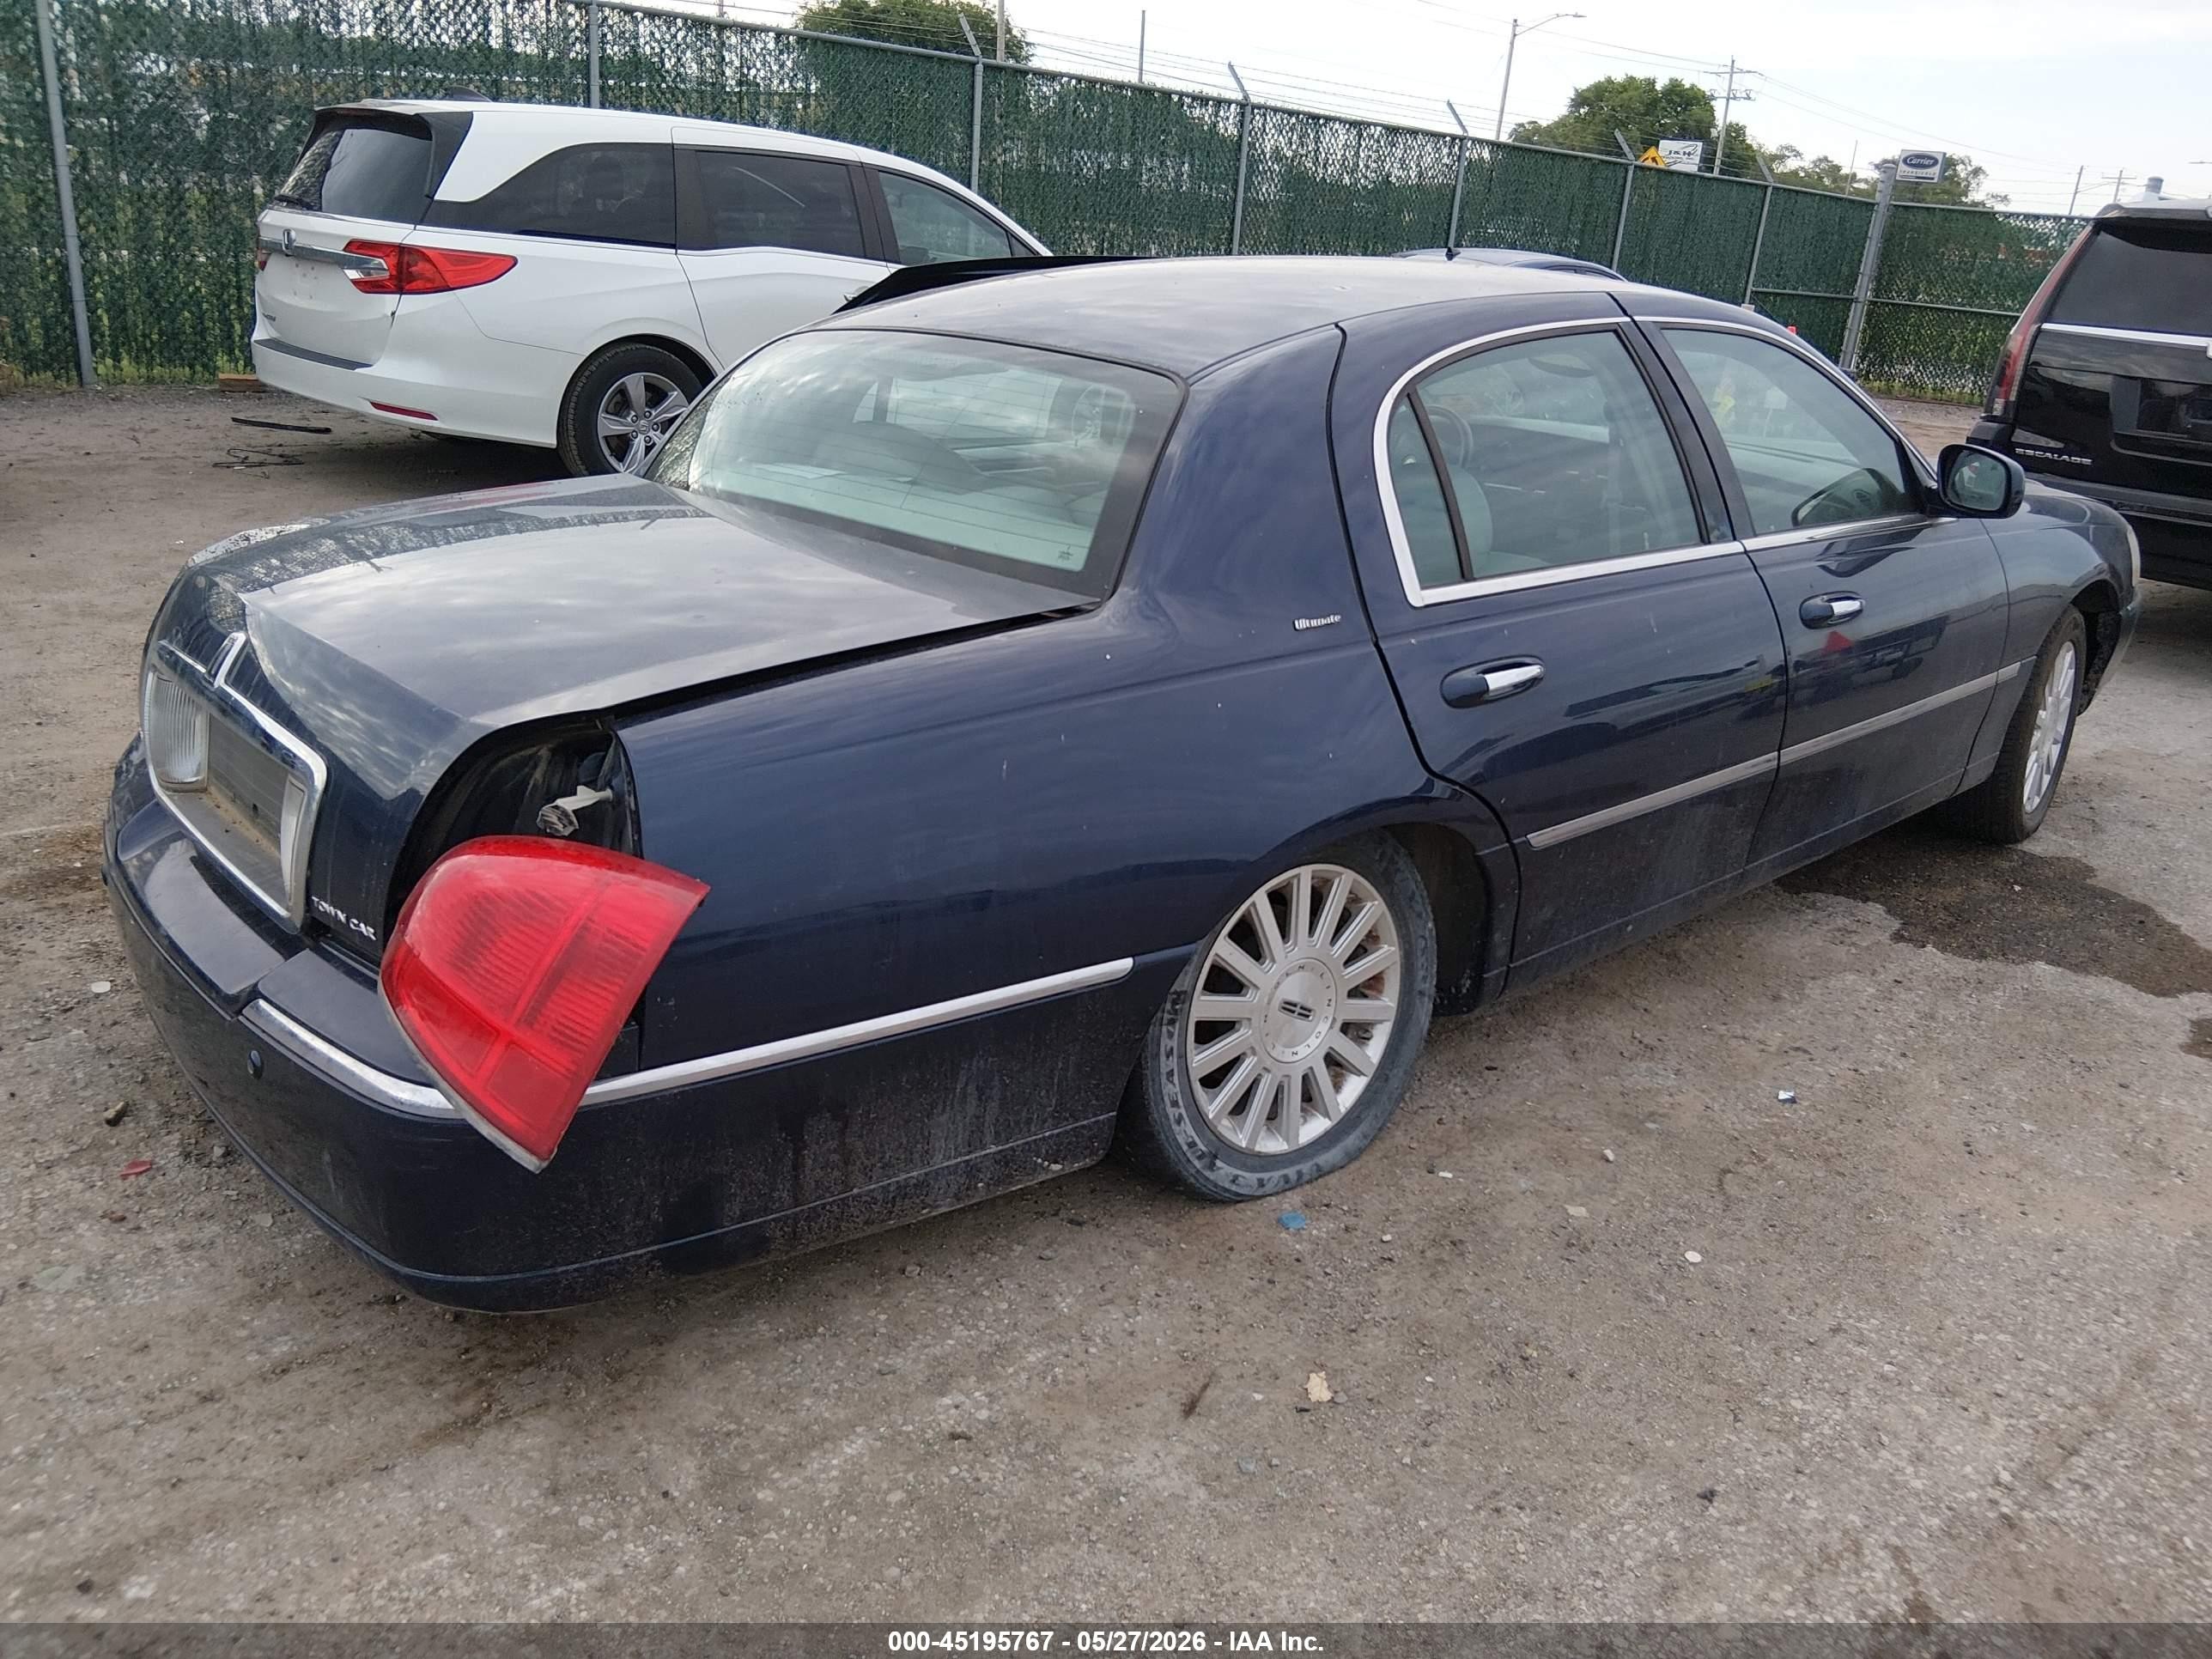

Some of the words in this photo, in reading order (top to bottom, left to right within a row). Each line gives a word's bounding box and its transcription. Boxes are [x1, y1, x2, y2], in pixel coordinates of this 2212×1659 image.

[1906, 156, 1935, 166] Carrier
[2014, 447, 2093, 465] ESCALADE
[1293, 614, 1341, 630] Ultimate
[311, 896, 347, 924] TOWN
[349, 918, 377, 941] CAR
